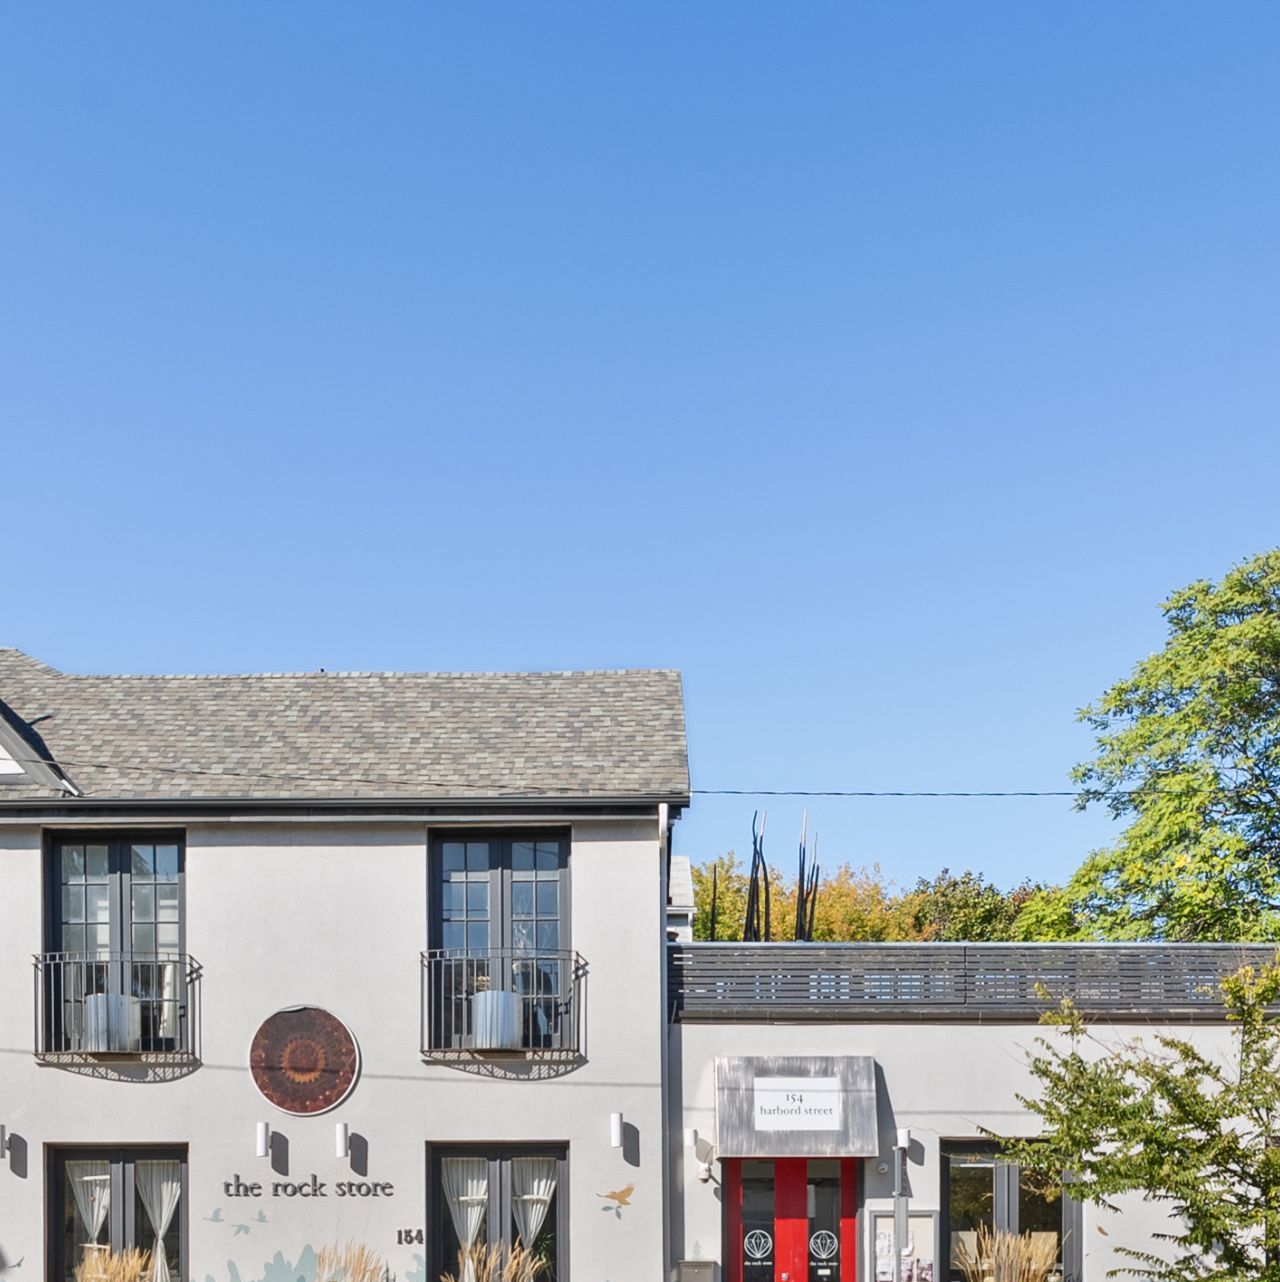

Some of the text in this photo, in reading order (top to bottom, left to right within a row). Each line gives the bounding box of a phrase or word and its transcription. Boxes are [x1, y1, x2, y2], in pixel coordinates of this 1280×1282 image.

[786, 1094, 803, 1104] 154
[760, 1106, 833, 1115] harbord street
[223, 1173, 394, 1197] the rock store
[397, 1228, 424, 1245] 154
